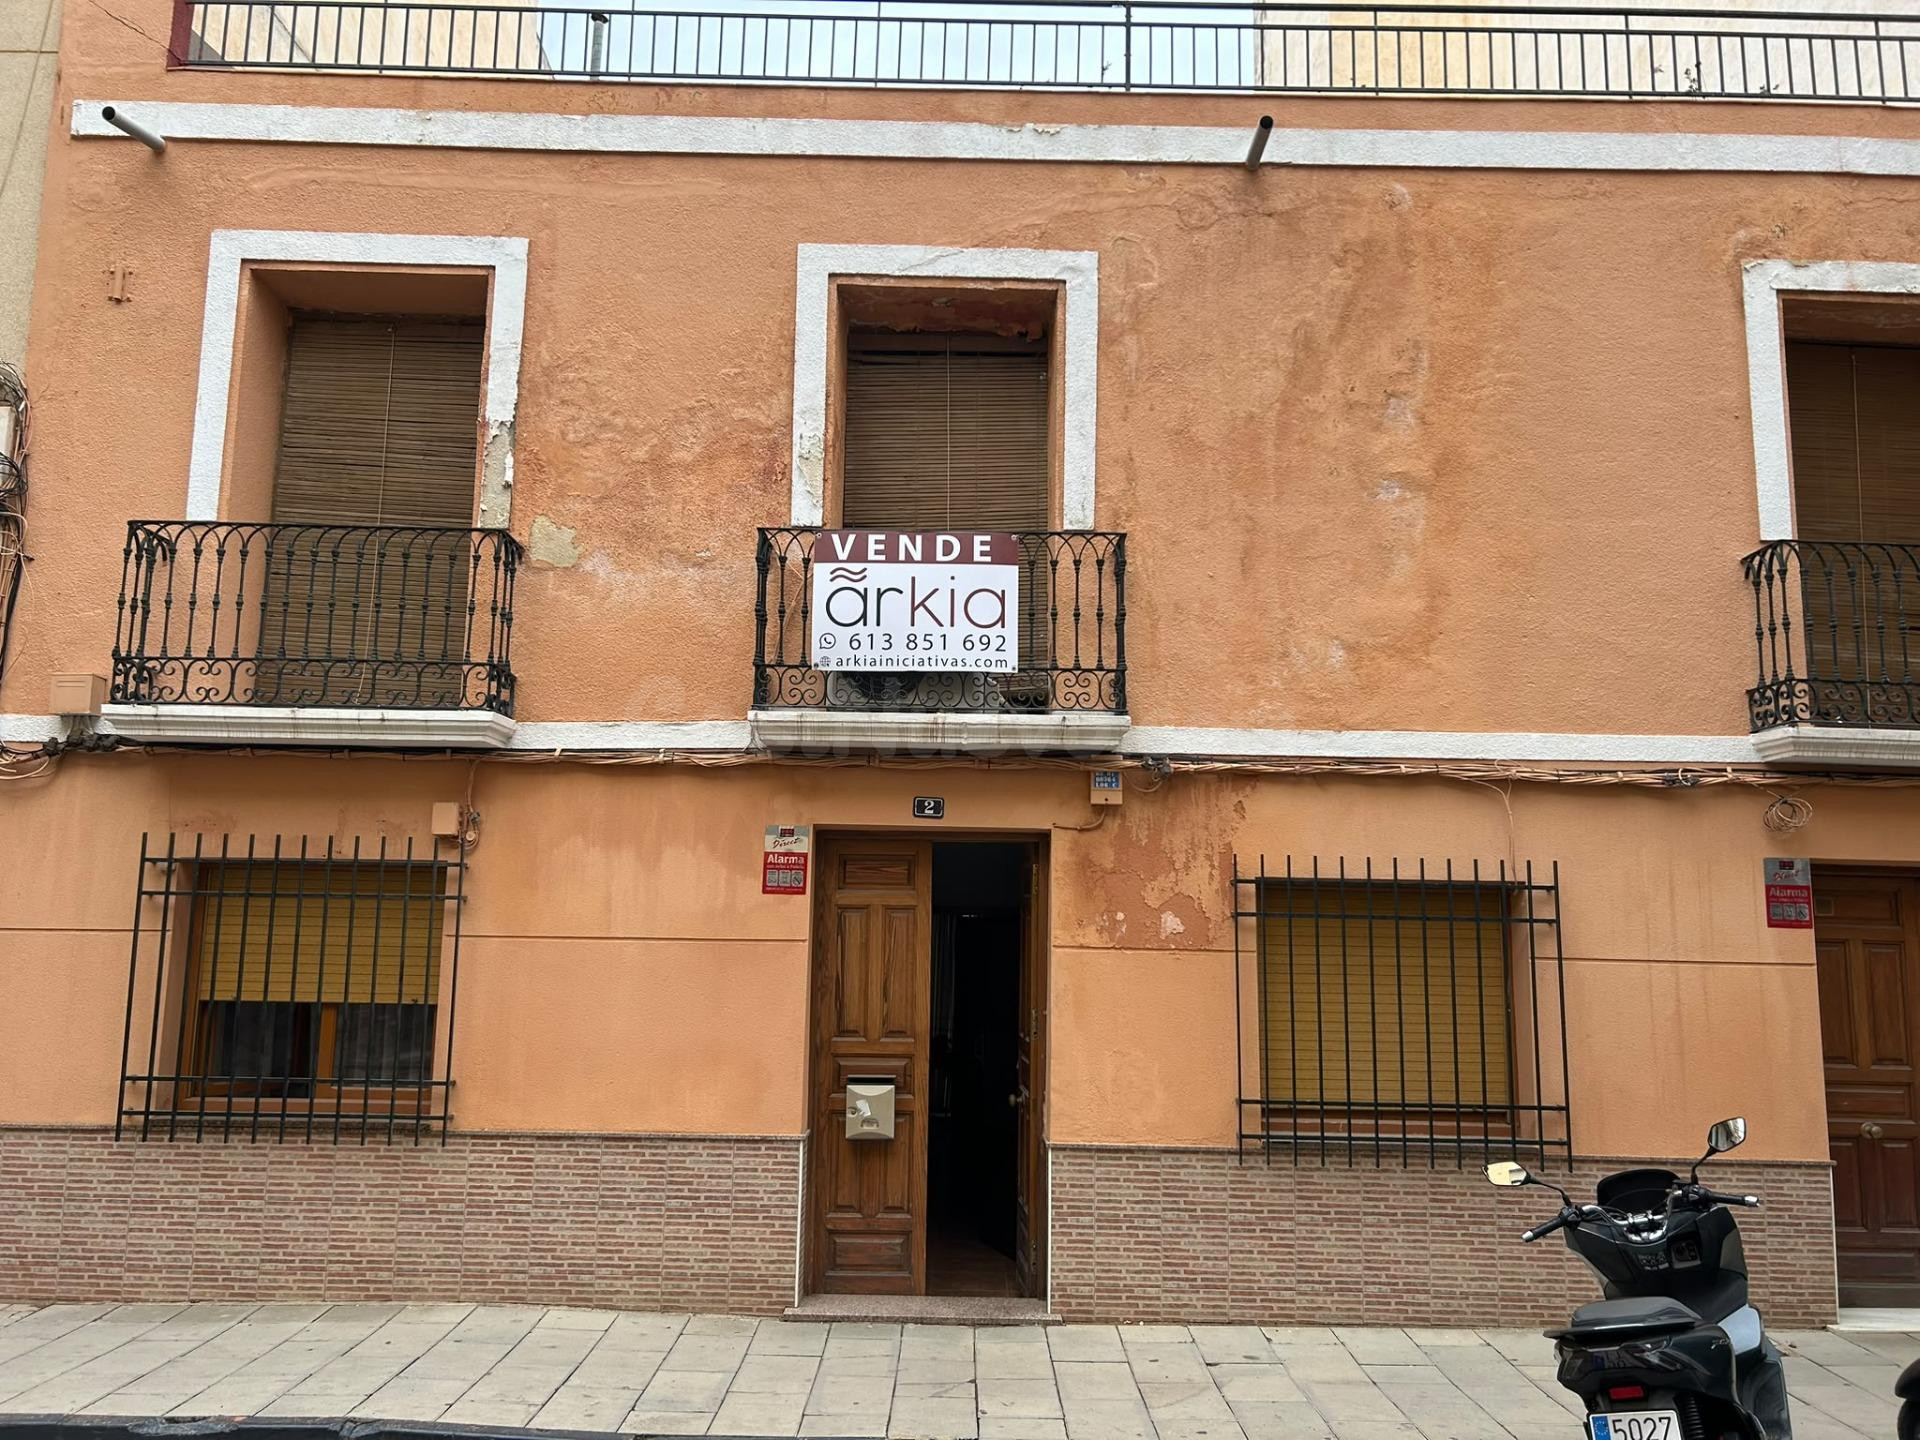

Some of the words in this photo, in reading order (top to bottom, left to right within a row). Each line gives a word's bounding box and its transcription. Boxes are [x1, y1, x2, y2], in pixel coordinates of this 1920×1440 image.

[831, 533, 992, 562] VENDE
[849, 632, 893, 651] 613
[906, 633, 949, 651] 851
[962, 634, 1006, 652] 692
[836, 654, 1008, 668] arkiainiciativas.com
[924, 800, 934, 814] 2
[767, 854, 804, 864] Alarma
[1769, 887, 1808, 897] Alarma
[1612, 1416, 1671, 1440] 5027
